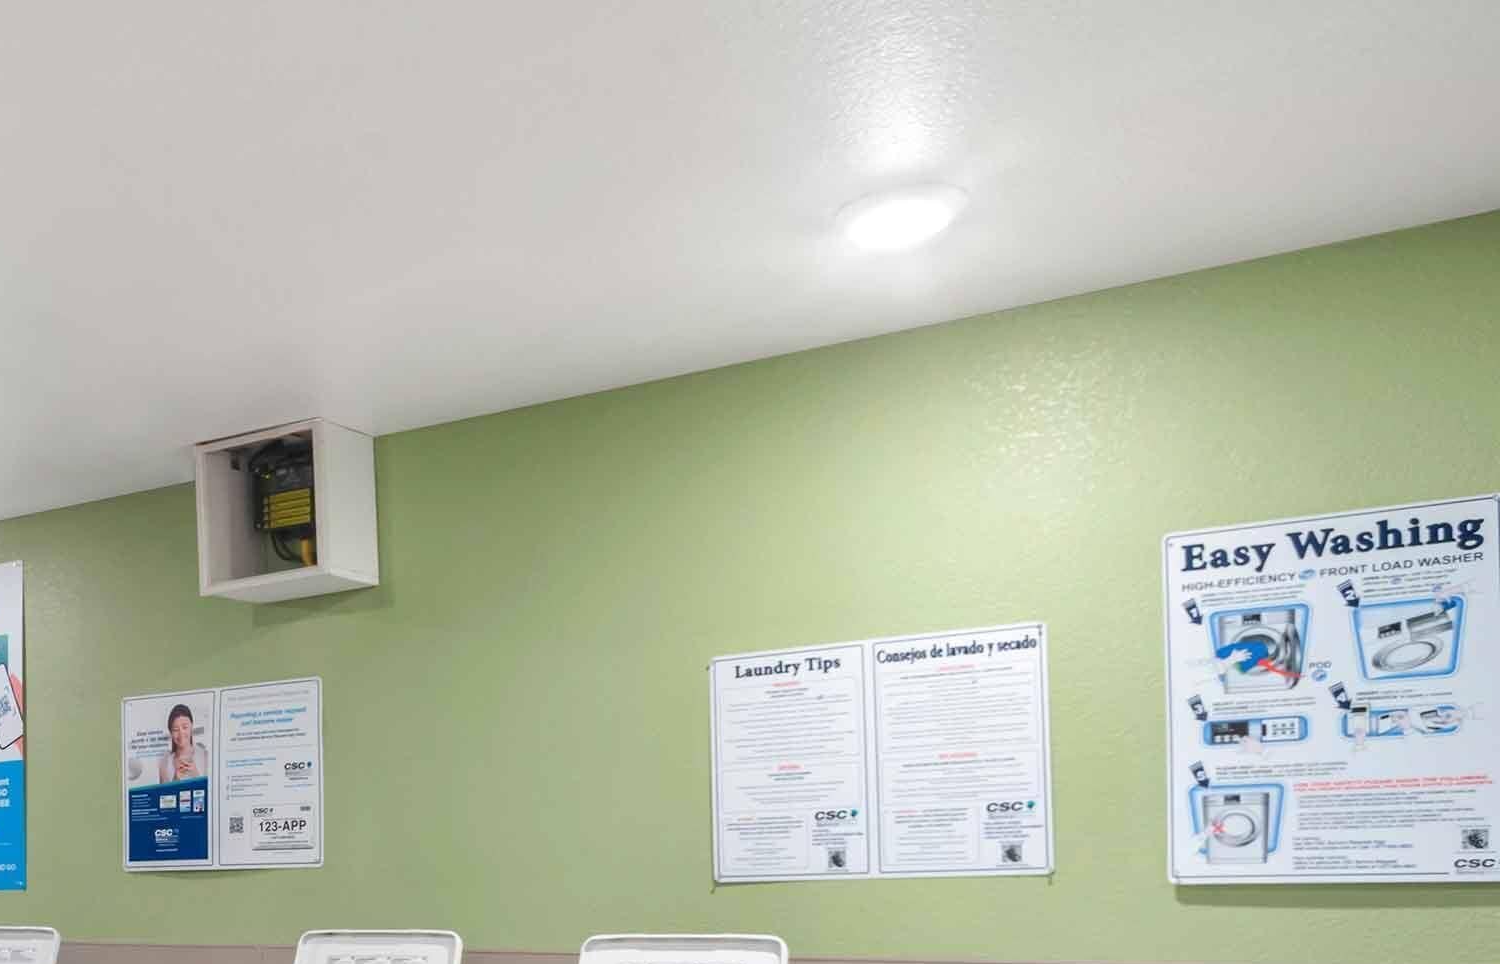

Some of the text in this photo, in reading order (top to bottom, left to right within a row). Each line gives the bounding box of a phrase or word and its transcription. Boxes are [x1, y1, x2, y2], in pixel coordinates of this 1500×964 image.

[1181, 518, 1485, 572] Easy Washing
[1181, 573, 1295, 593] HIGH-EFFICIENCY
[1319, 564, 1368, 577] FRONT
[1372, 559, 1413, 573] LOAD
[1417, 552, 1484, 568] WASHER
[877, 648, 927, 664] Consejos
[930, 644, 943, 658] de
[946, 640, 984, 657] lavado
[997, 635, 1037, 651] secado
[735, 657, 841, 678] Laundry Tips
[284, 761, 305, 770] CSC
[986, 801, 1024, 813] CSC
[814, 809, 848, 821] CSC
[260, 820, 307, 832] 123-APP
[1454, 858, 1496, 868] CSC
